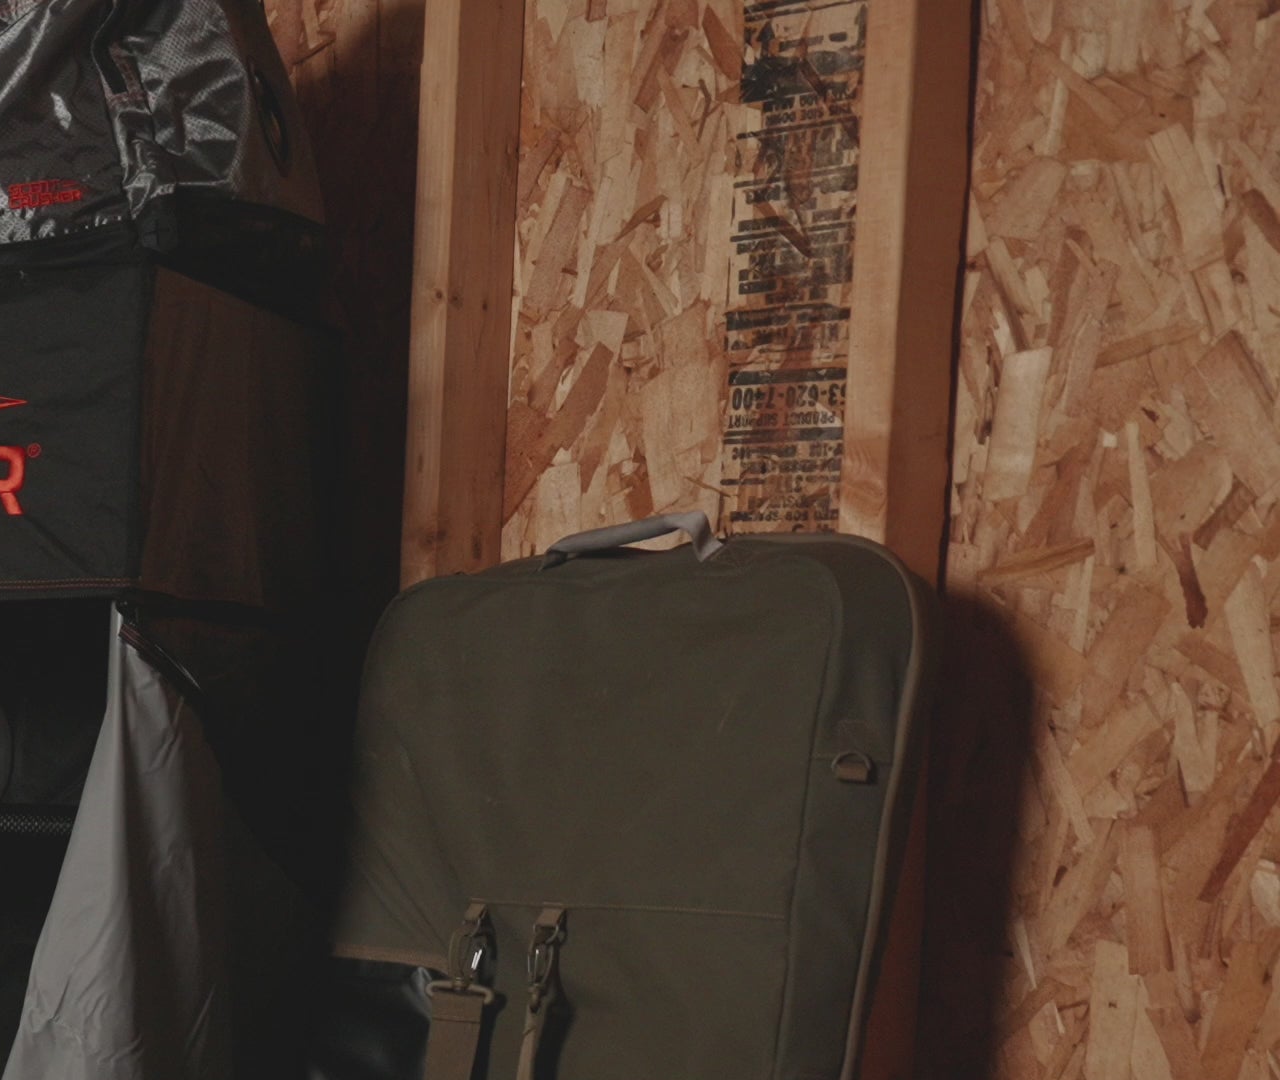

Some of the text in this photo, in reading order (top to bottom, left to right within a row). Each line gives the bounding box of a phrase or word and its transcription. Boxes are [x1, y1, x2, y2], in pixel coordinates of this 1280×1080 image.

[8, 178, 61, 195] SCENT
[9, 189, 83, 210] CRUSHER
[781, 411, 836, 427] PRODUCT
